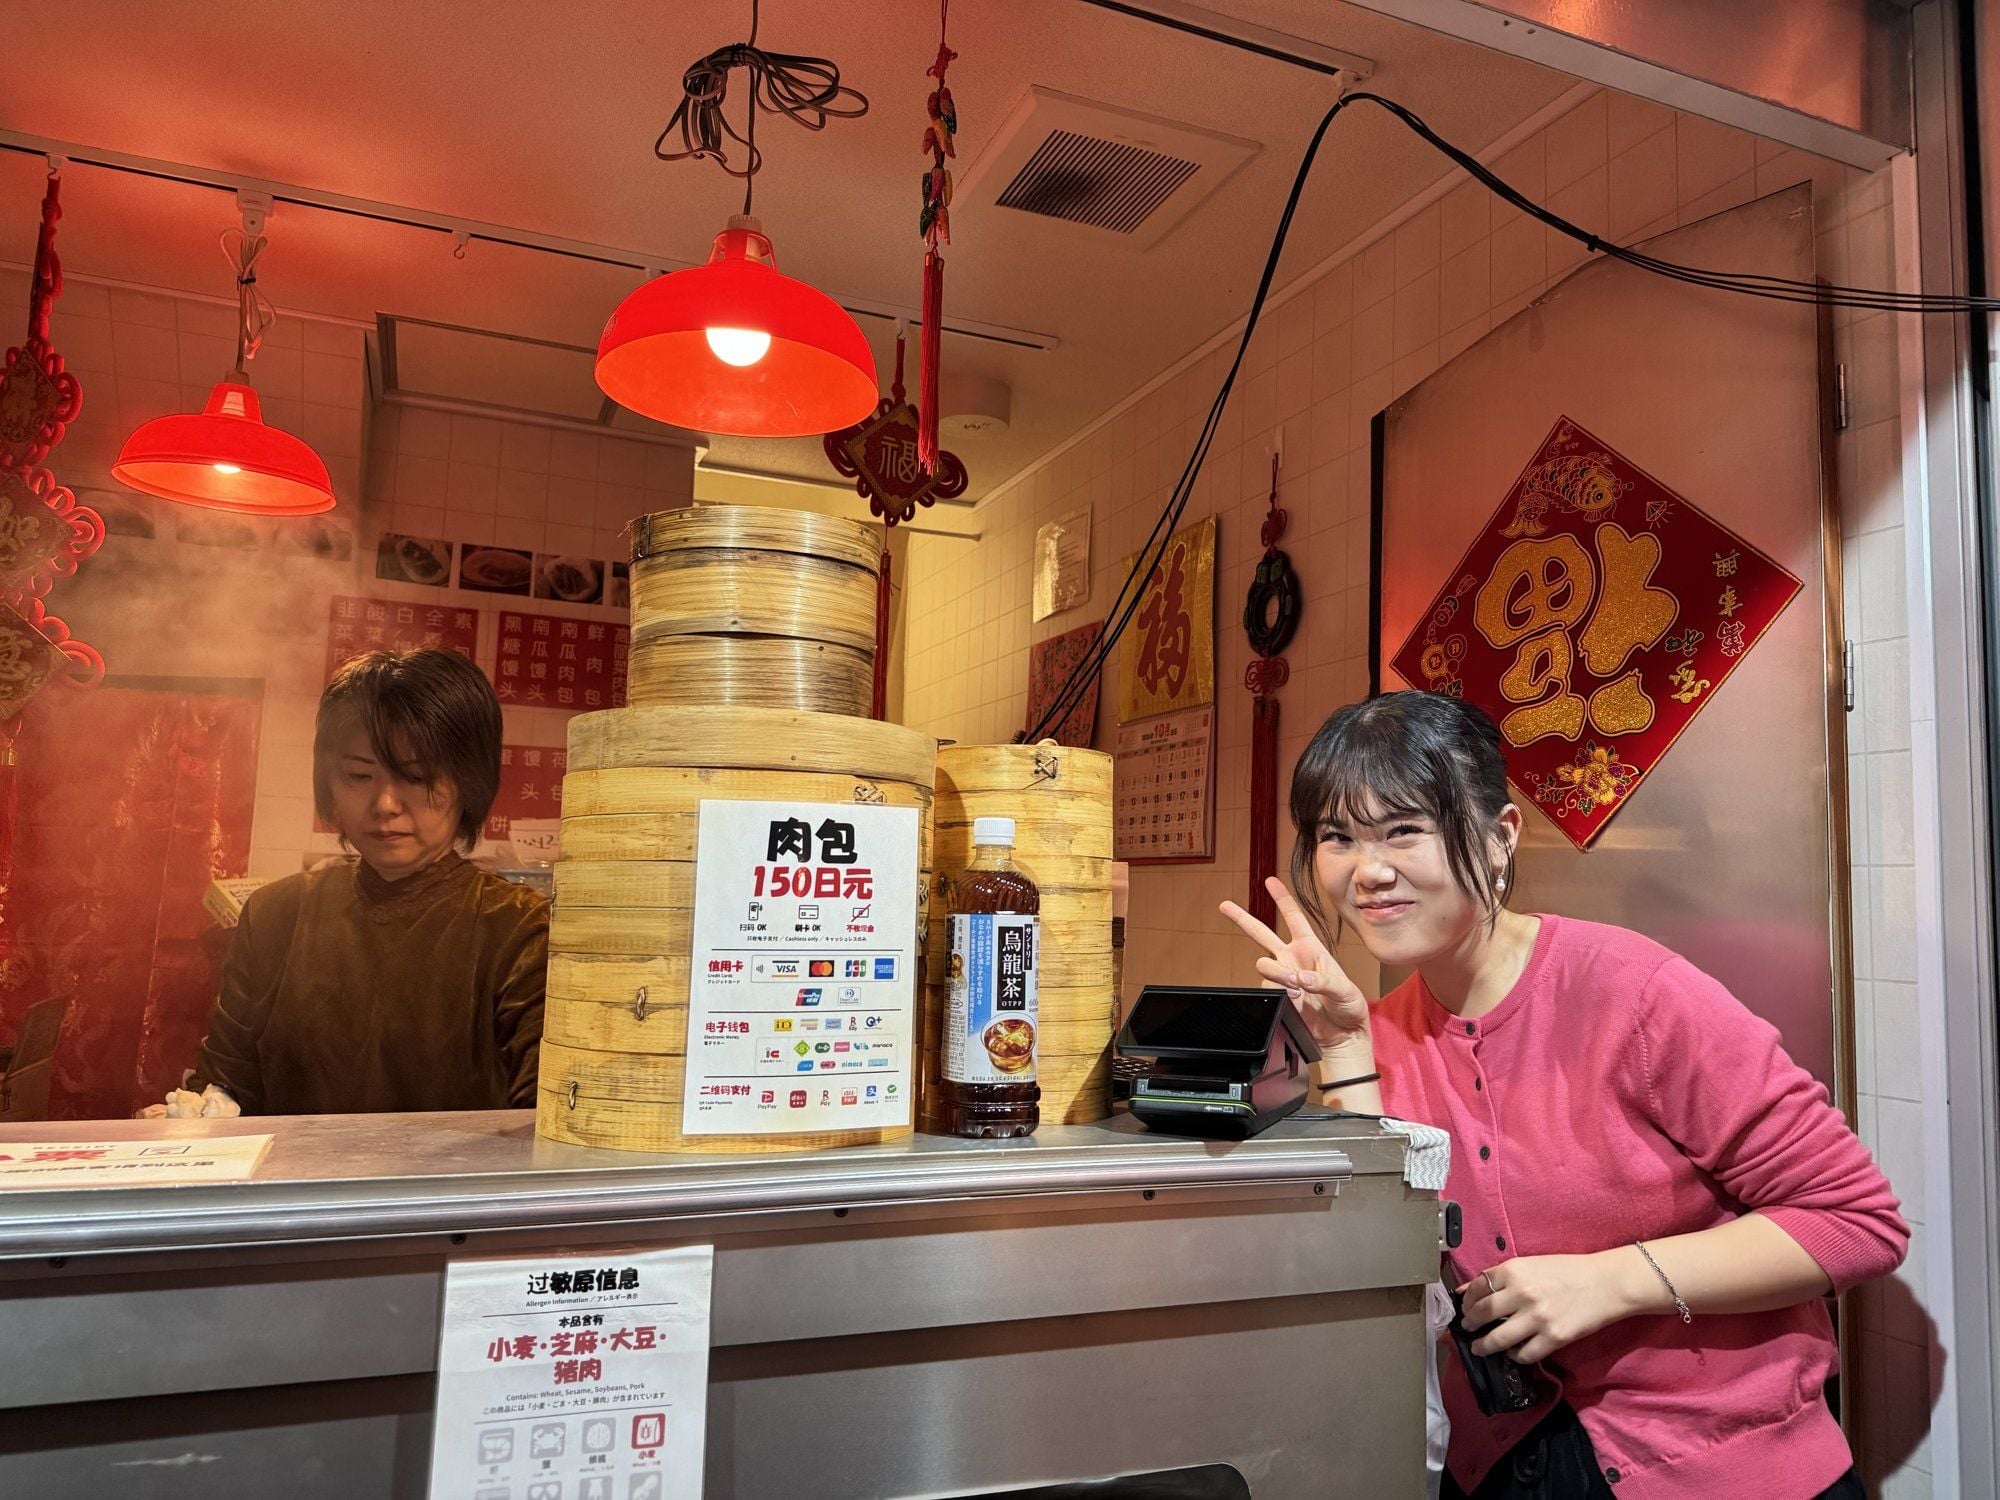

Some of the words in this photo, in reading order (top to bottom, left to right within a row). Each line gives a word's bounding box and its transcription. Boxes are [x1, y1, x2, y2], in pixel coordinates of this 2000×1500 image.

[879, 434, 918, 484] 福
[1136, 542, 1192, 701] 福
[584, 624, 605, 705] 鲜肉包
[1179, 791, 1186, 800] 17
[1164, 813, 1171, 823] 23
[1177, 812, 1184, 822] 24
[766, 816, 858, 864] 肉包
[1176, 832, 1183, 842] 31
[753, 865, 873, 900] 150日元
[708, 960, 744, 972] 信用卡
[776, 965, 797, 973] VISA
[1002, 930, 1022, 999] 烏龍茶
[705, 1021, 750, 1033] 电子钱包
[700, 1085, 751, 1096] 二维码支付
[527, 1267, 640, 1295] 过敏原信息
[525, 1299, 552, 1308] Allergen
[552, 1296, 589, 1306] Information
[558, 1314, 605, 1329] 本品含有
[554, 1358, 602, 1385] 猪肉
[506, 1392, 539, 1402] Contains:
[540, 1390, 563, 1400] Wheat,
[565, 1387, 594, 1397] Sesame,
[594, 1384, 628, 1394] Soybeans,
[629, 1382, 645, 1391] Pork
